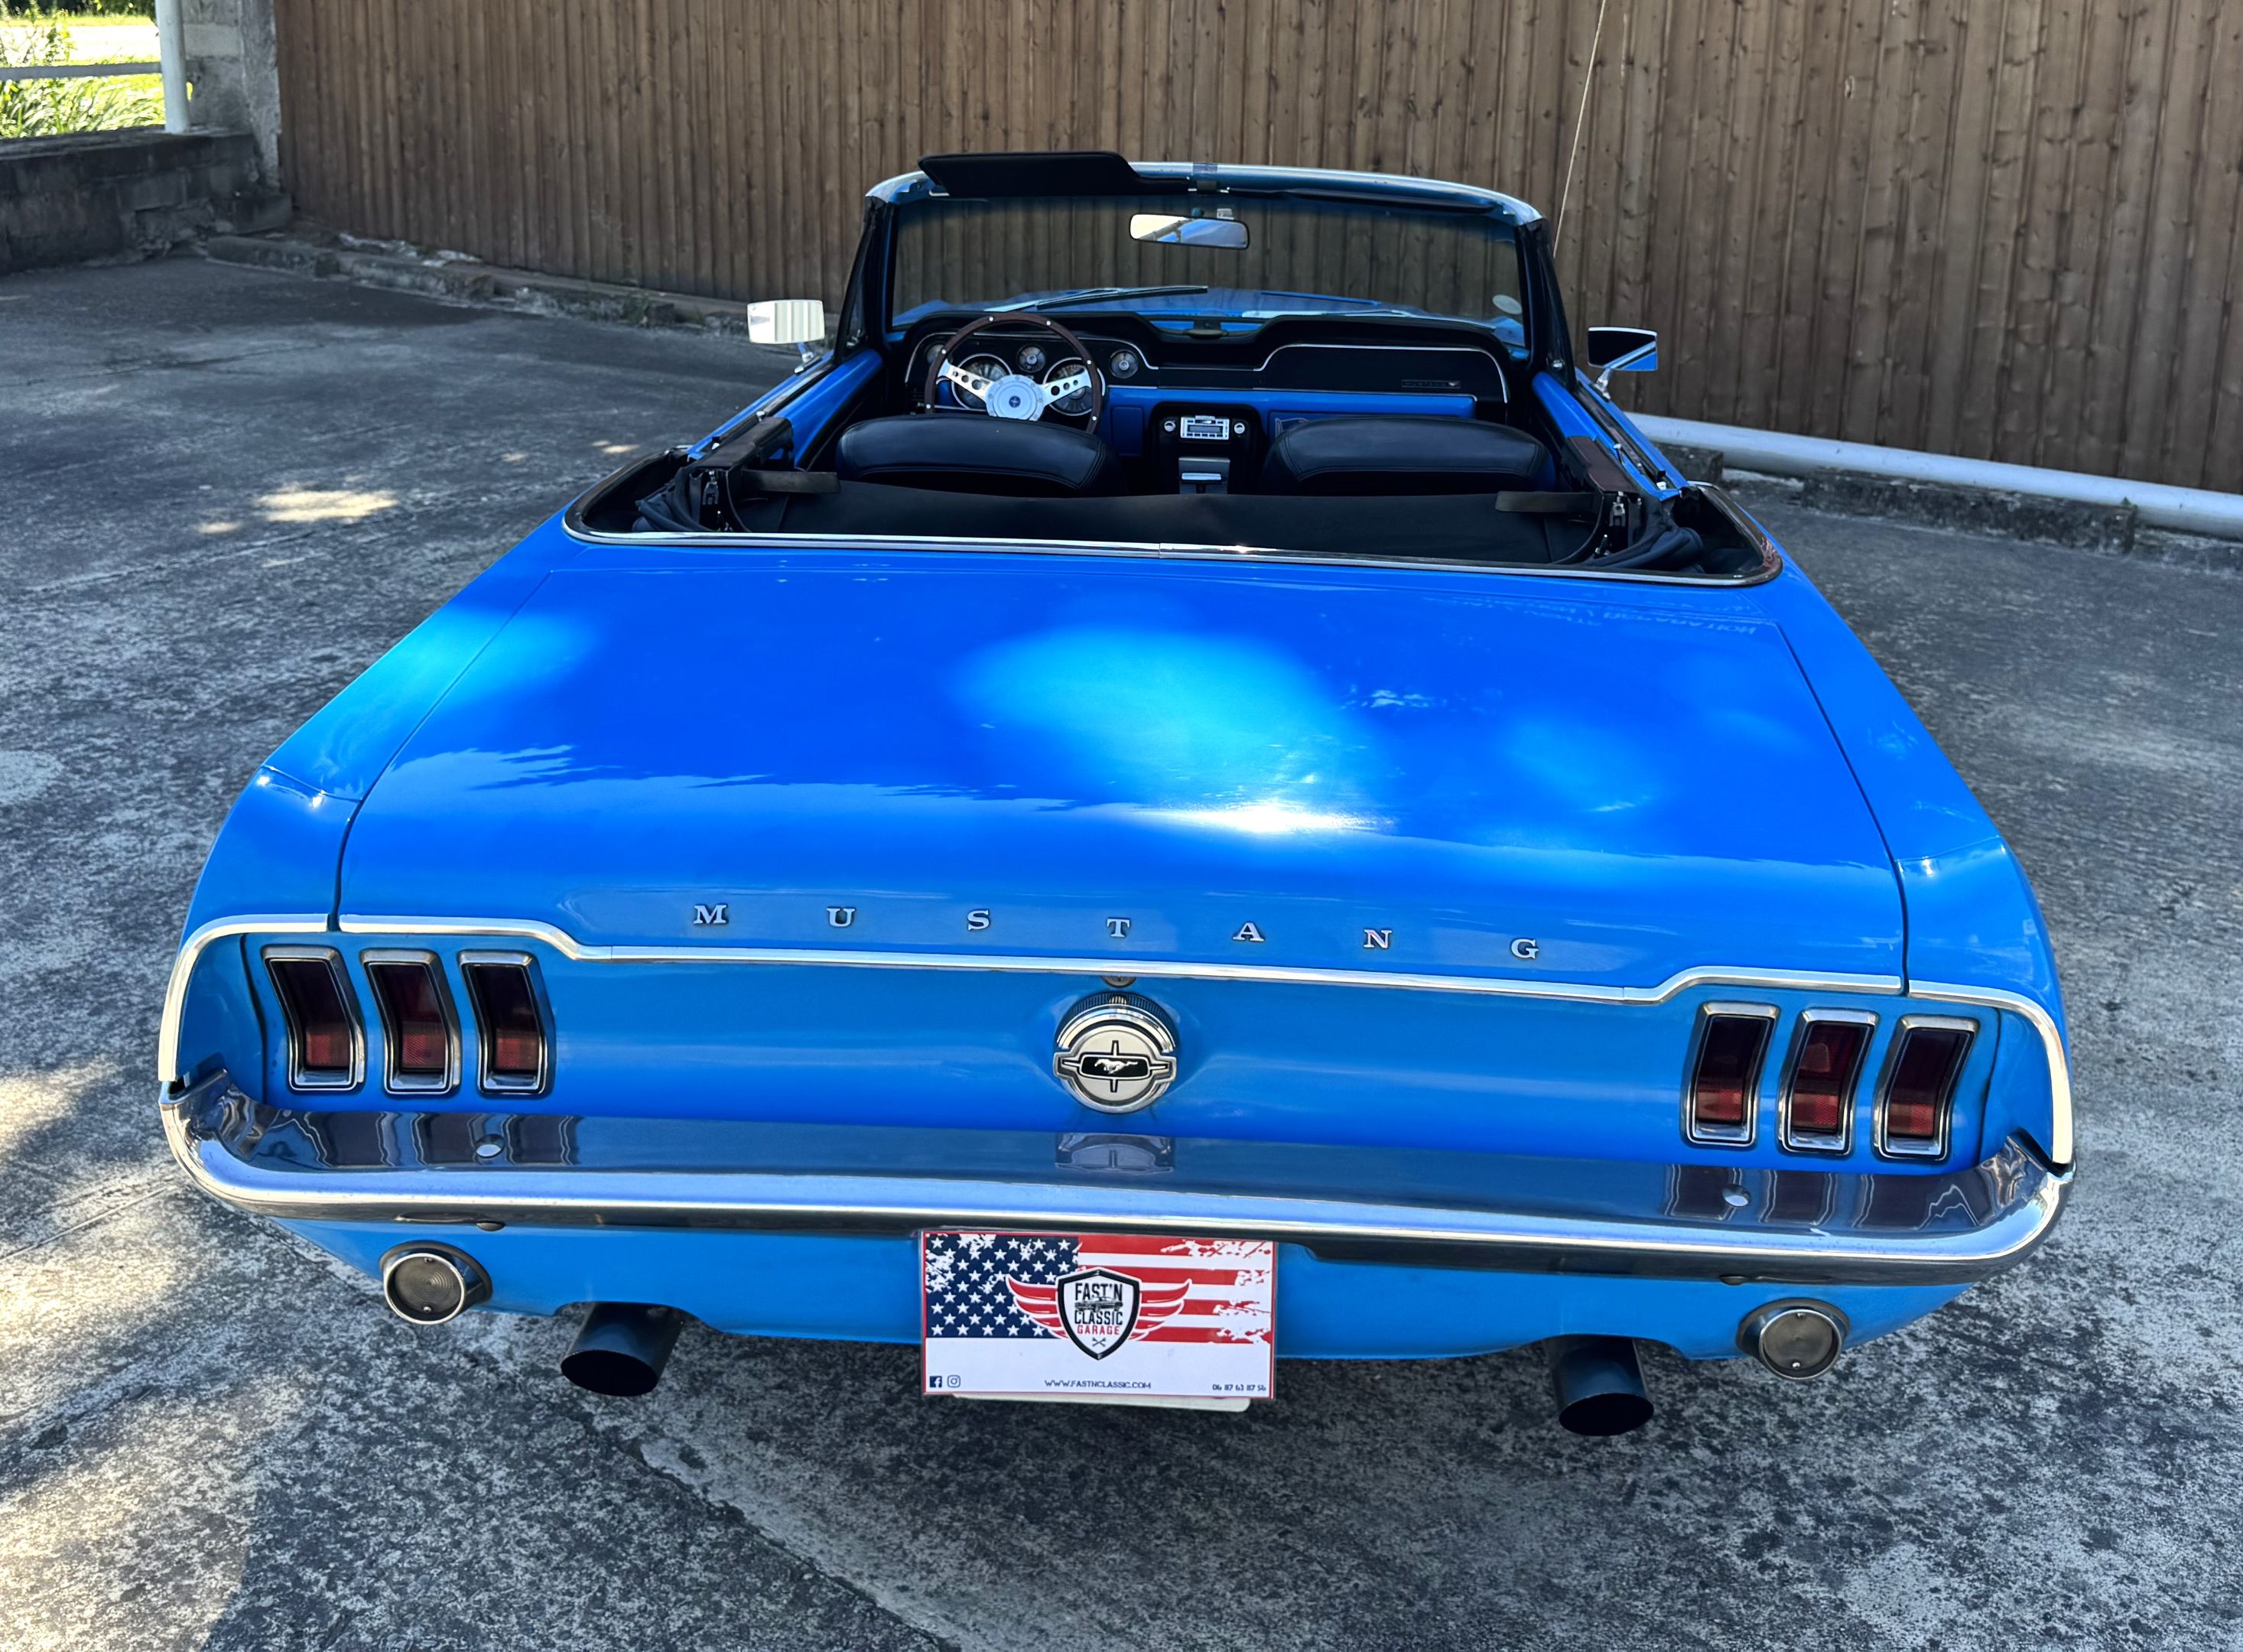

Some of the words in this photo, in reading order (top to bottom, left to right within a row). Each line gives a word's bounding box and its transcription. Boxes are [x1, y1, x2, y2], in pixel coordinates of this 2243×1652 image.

[692, 903, 1539, 960] MUSTANG
[1074, 1283, 1123, 1301] FAST'N
[1074, 1309, 1123, 1325] CLASSIC
[1077, 1325, 1120, 1335] GARAGE
[1044, 1379, 1152, 1389] WWW.FASTNCLASSIC.COM
